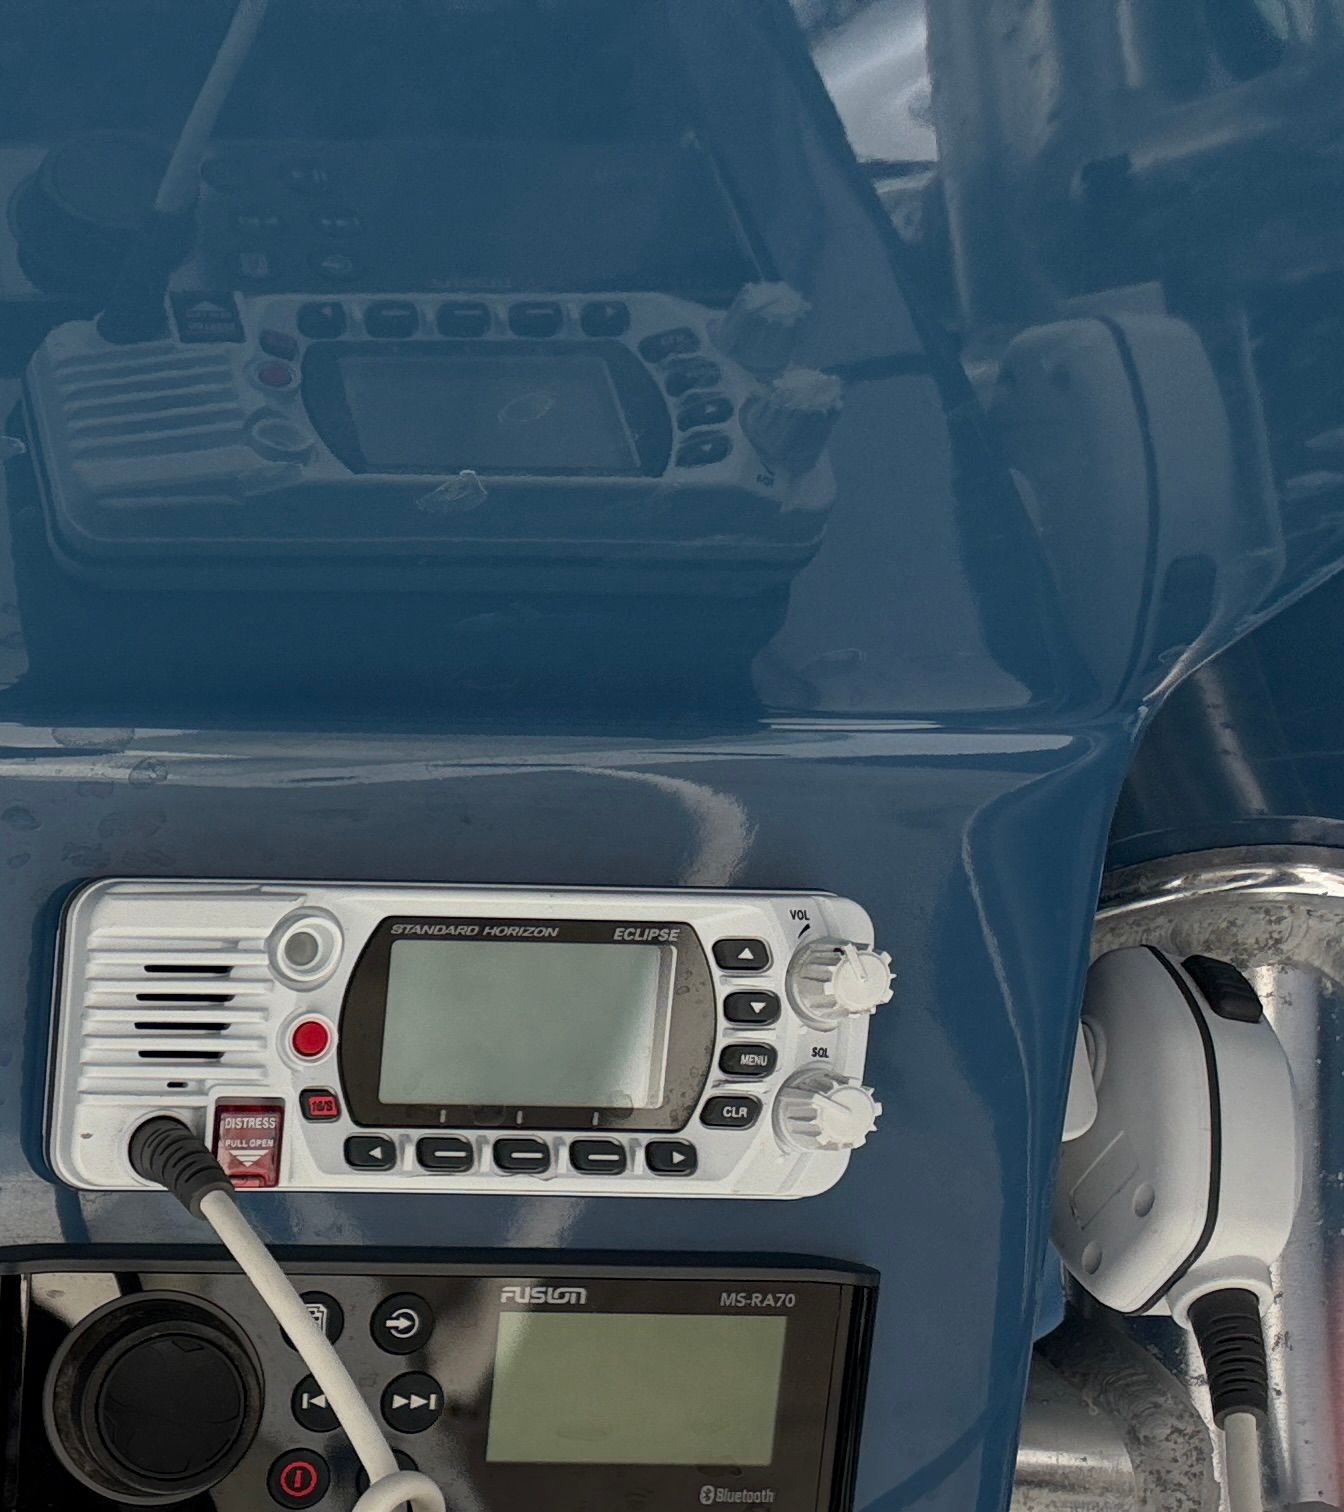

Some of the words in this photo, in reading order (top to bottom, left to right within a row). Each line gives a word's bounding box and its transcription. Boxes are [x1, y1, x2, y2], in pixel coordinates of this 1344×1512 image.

[789, 909, 810, 921] VOL
[390, 924, 479, 937] STANDARD
[483, 926, 559, 938] HORIZON
[613, 927, 681, 942] ECLIPSE
[811, 1046, 830, 1059] SQL
[740, 1053, 768, 1066] MENU
[722, 1106, 748, 1118] CLR
[224, 1117, 276, 1129] DISTRESS
[225, 1139, 248, 1148] PULL
[249, 1139, 274, 1148] OPEN
[719, 1291, 796, 1308] MS-RA70
[715, 1487, 776, 1503] Bluetooth
